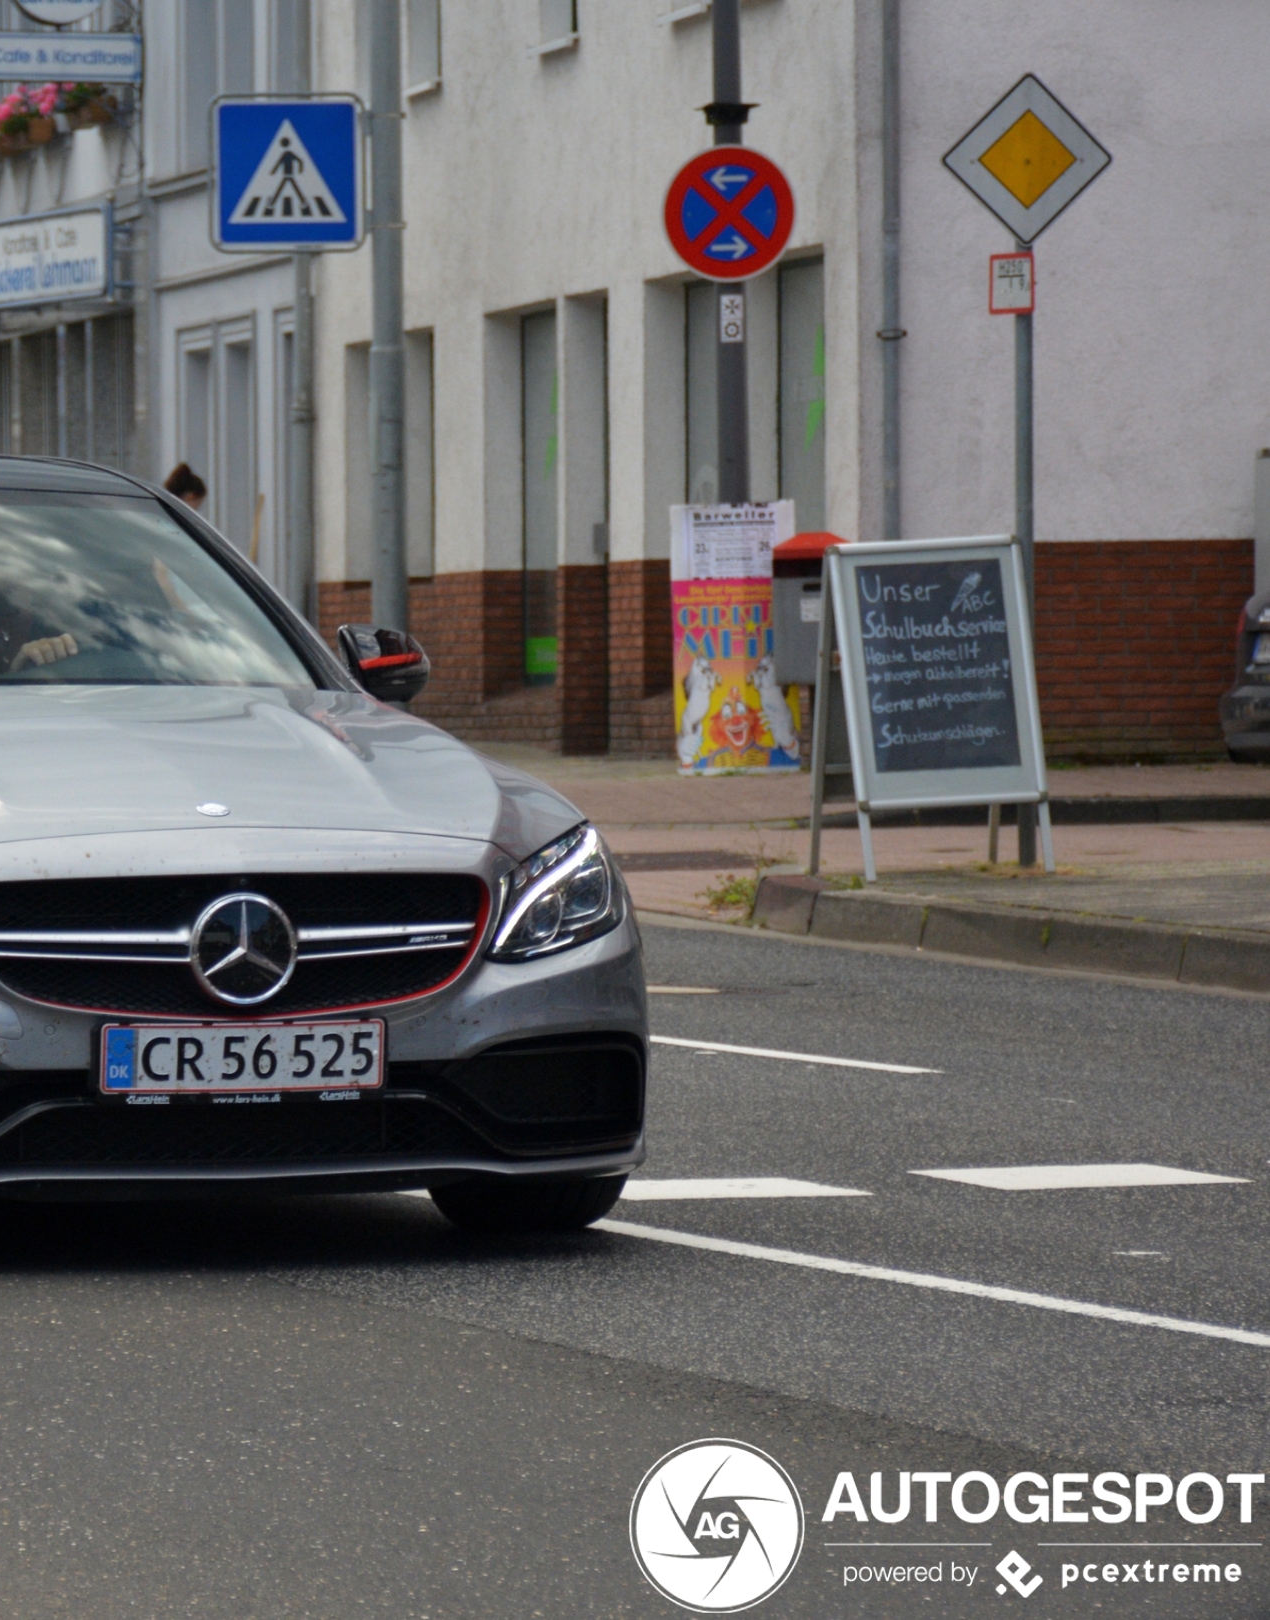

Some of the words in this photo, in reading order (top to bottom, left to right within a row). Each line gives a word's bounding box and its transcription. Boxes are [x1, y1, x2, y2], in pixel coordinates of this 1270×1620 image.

[36, 49, 48, 63] &
[860, 574, 941, 603] Unser
[961, 590, 996, 613] ABC
[865, 646, 908, 665] Heute
[911, 641, 981, 662] bestellt
[884, 669, 922, 685] morgen
[871, 692, 914, 714] Gerne
[917, 692, 941, 710] mit
[142, 1036, 205, 1082] CR
[221, 1034, 278, 1081] 56
[292, 1031, 374, 1078] 525
[109, 1065, 129, 1079] DK
[212, 1093, 282, 1104] www.lars-hein.dk
